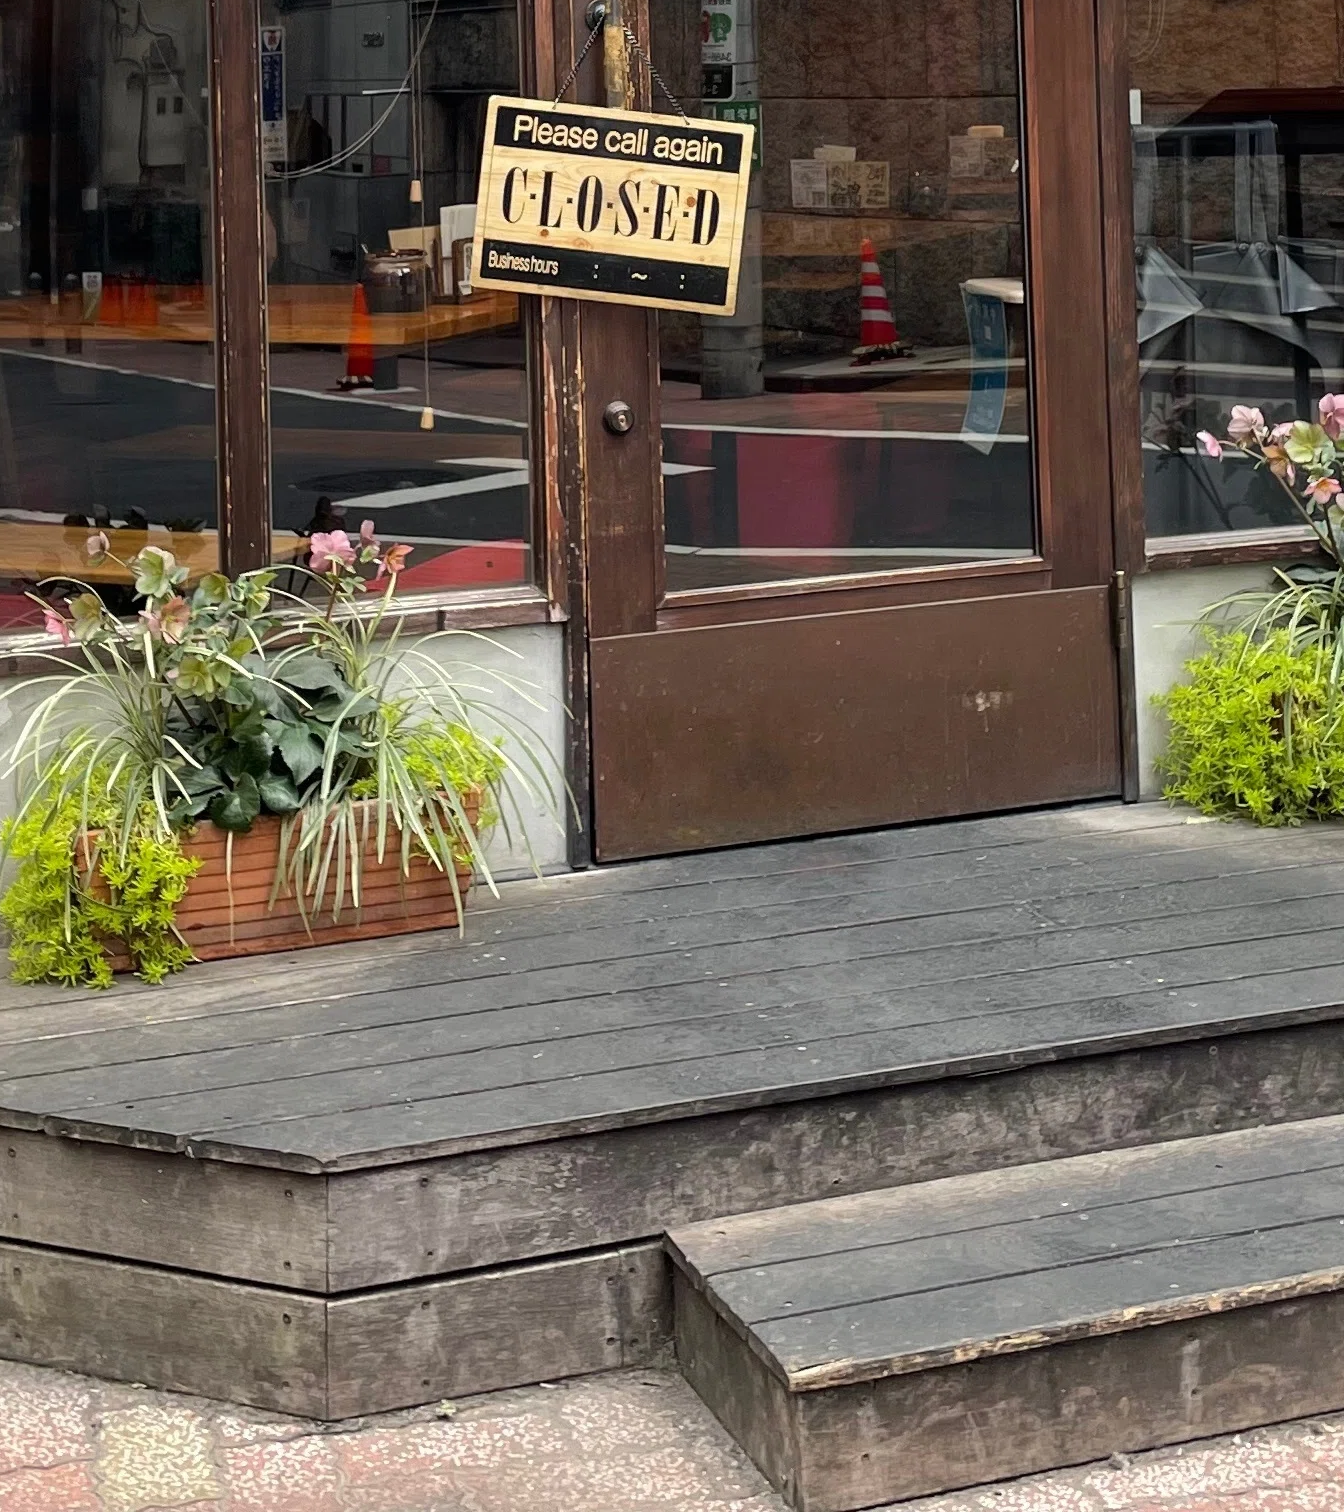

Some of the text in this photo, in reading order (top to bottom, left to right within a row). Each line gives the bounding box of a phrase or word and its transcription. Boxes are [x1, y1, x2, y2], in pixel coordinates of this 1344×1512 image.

[513, 114, 724, 165] Please call again
[487, 249, 560, 277] Business hours
